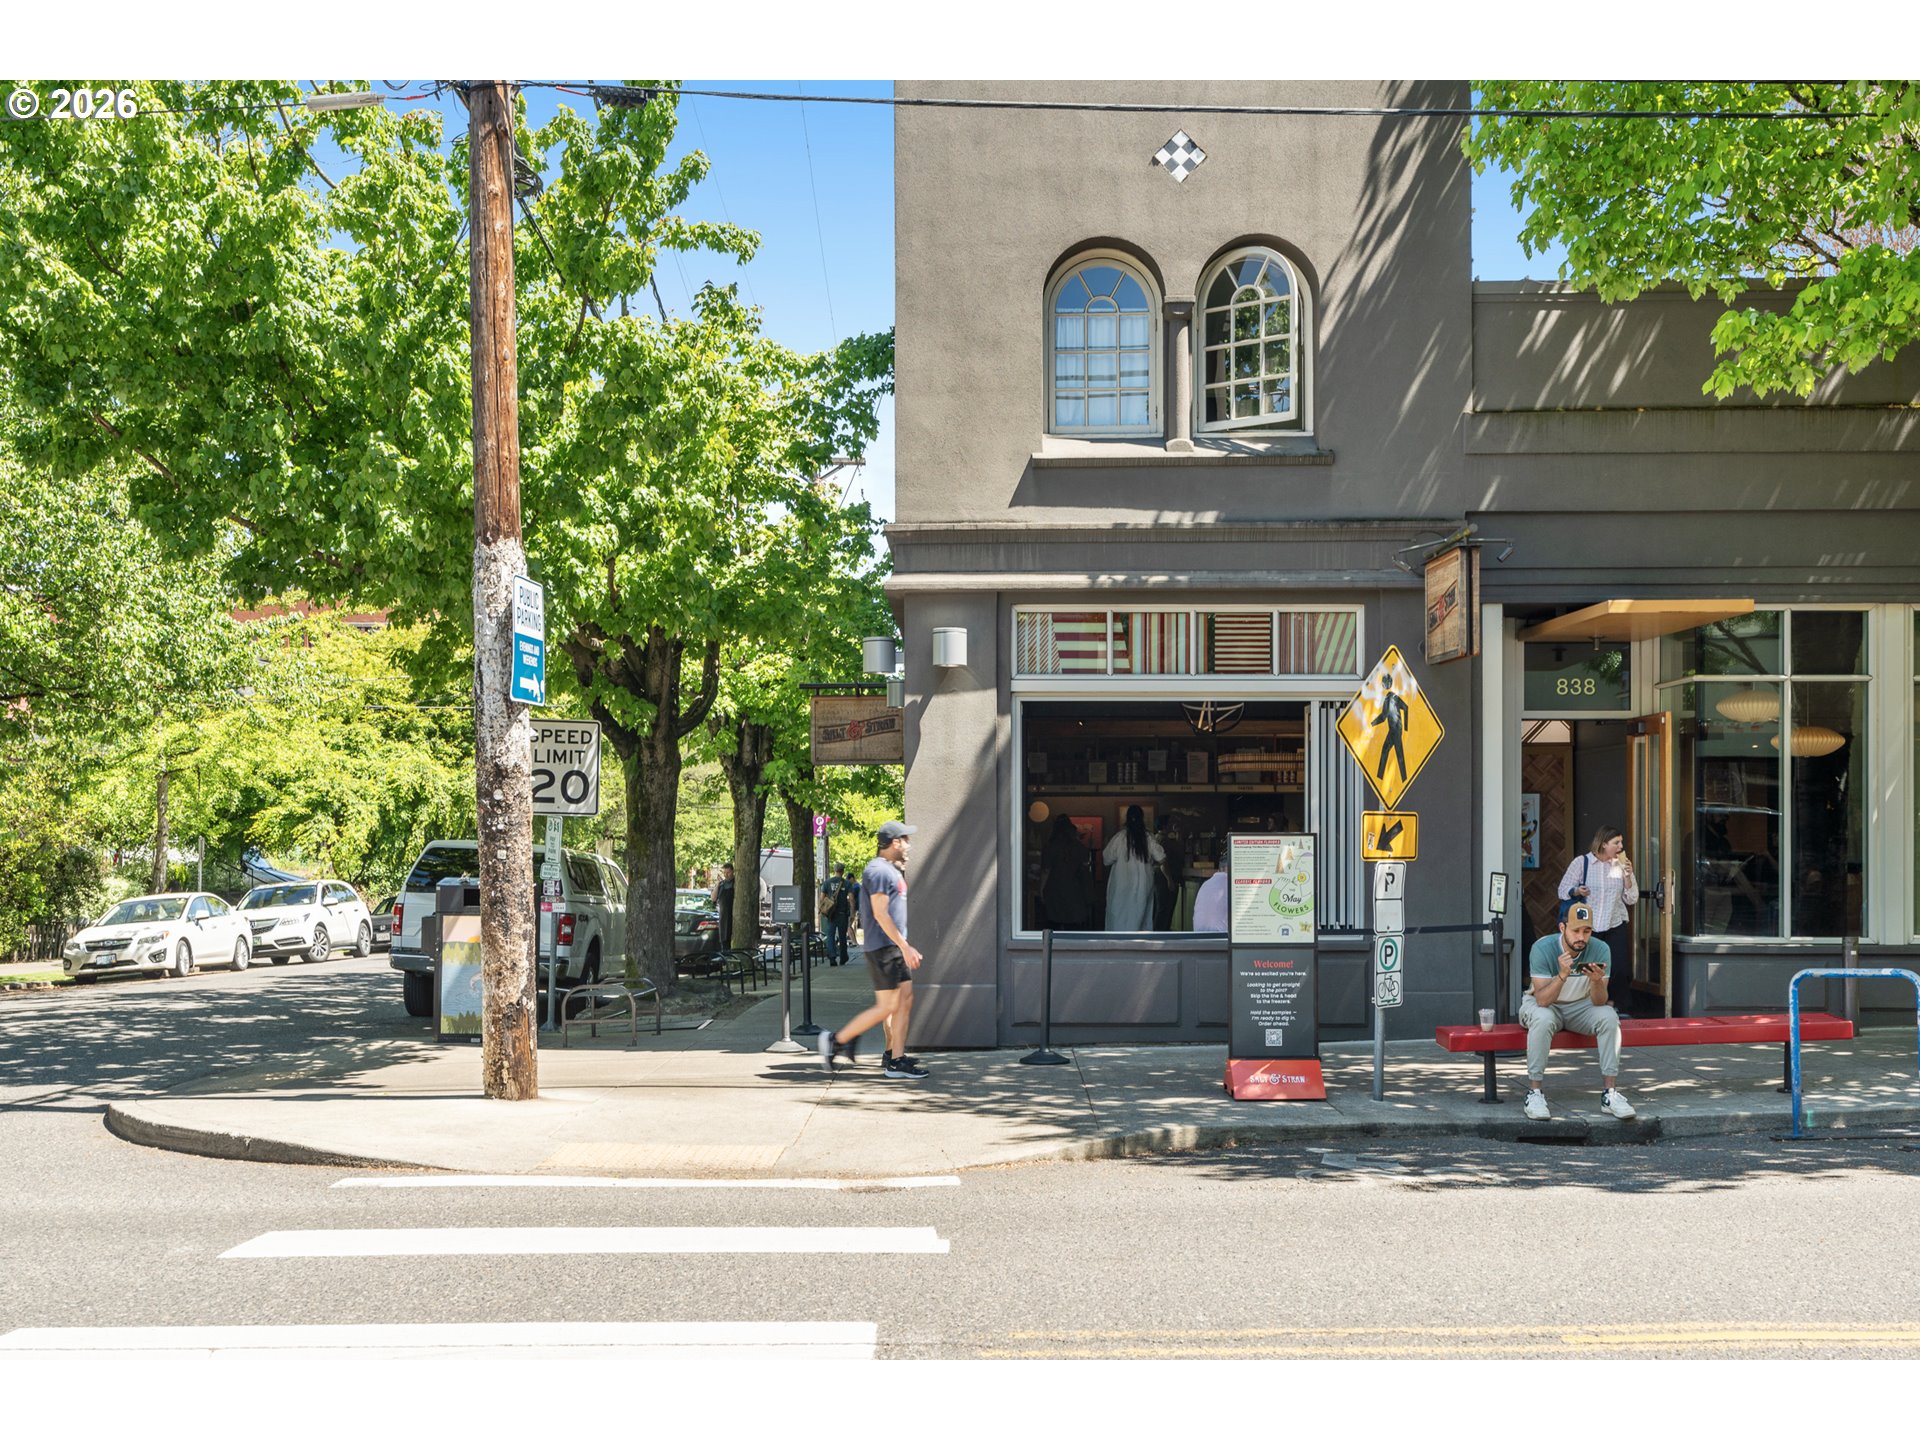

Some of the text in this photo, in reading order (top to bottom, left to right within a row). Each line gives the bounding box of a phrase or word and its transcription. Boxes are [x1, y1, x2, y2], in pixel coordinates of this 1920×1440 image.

[519, 585, 540, 610] PUBLIC
[517, 606, 542, 632] PARKING
[1556, 678, 1596, 695] 838
[534, 749, 586, 765] LIMIT
[531, 768, 590, 805] 20
[1282, 894, 1302, 904] May
[1273, 902, 1309, 914] FLOWERS
[1384, 944, 1394, 965] P
[1253, 960, 1294, 968] Welcome!
[1269, 1073, 1280, 1085] &
